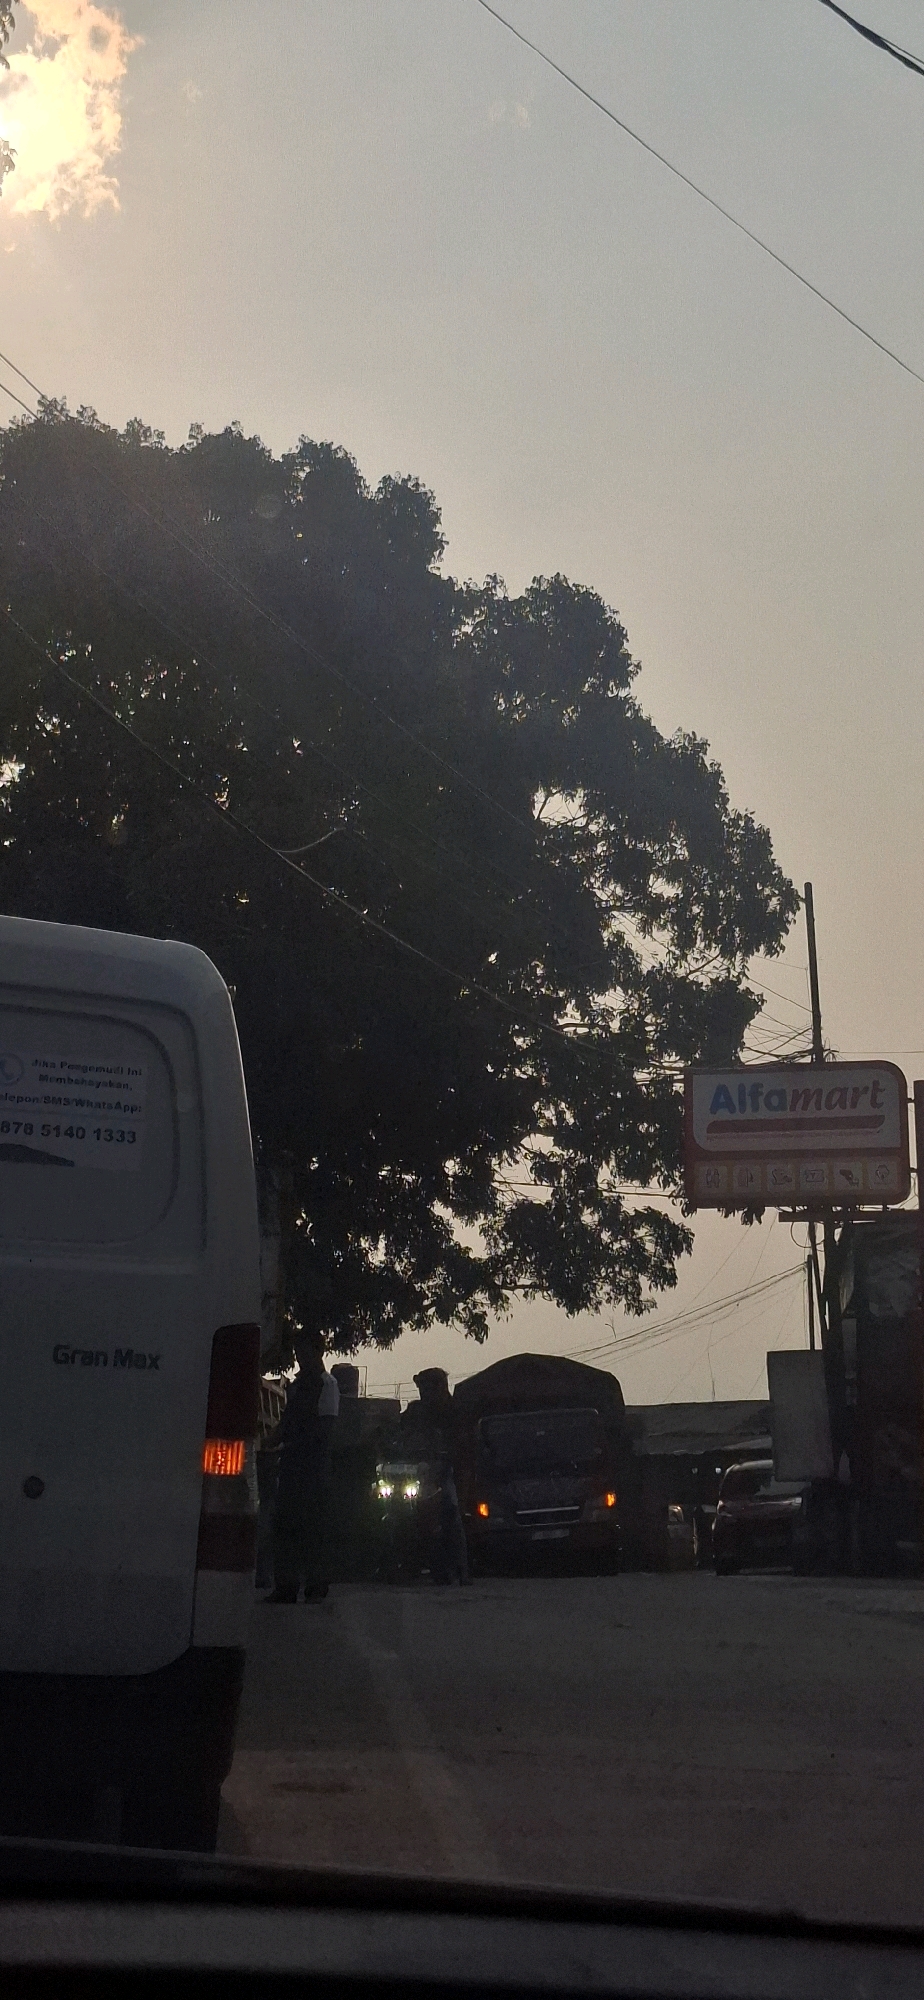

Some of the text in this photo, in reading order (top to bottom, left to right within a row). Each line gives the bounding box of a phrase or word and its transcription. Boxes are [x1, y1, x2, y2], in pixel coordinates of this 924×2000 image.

[32, 1059, 56, 1069] Jika
[127, 1067, 143, 1076] Ini
[709, 1079, 886, 1115] Alfamart
[40, 1124, 86, 1140] 5140
[93, 1127, 137, 1144] 1333
[52, 1344, 160, 1370] Gran Max
